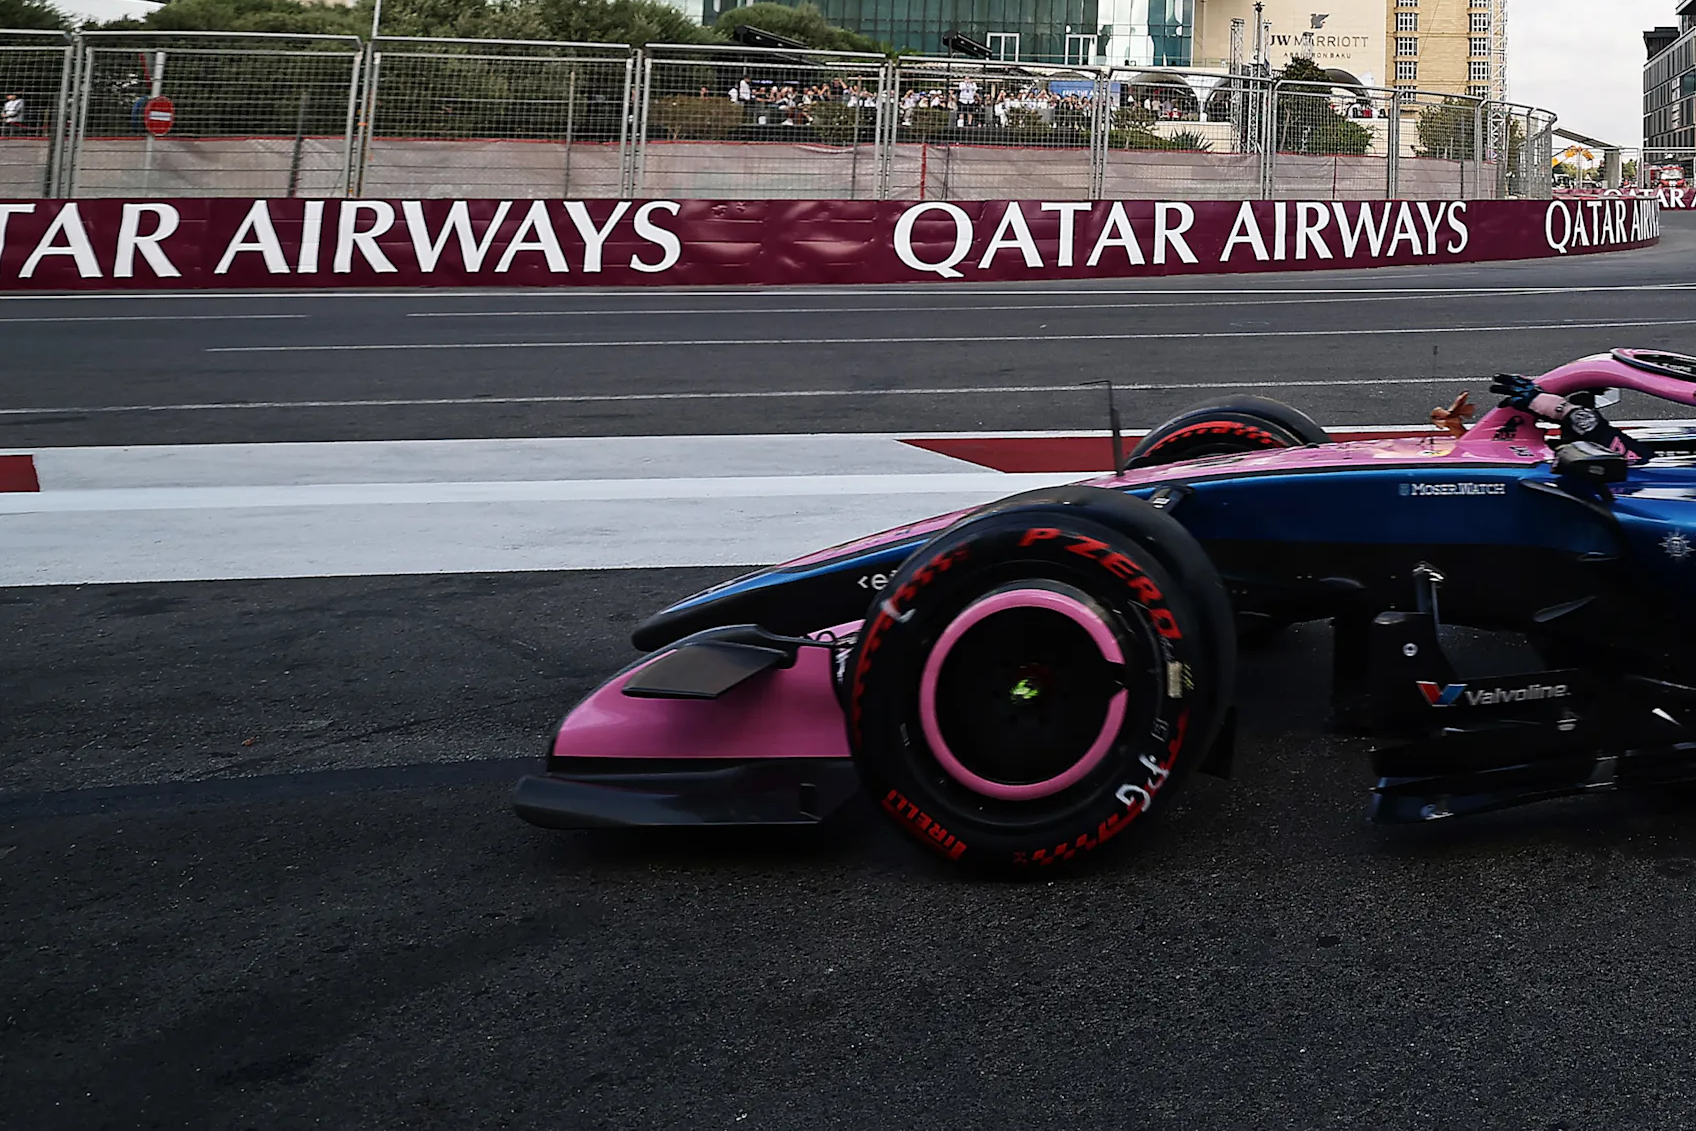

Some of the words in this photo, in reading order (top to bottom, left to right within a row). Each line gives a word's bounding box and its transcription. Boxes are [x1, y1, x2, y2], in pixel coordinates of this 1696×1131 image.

[1269, 35, 1292, 46] JW
[1294, 35, 1369, 47] MRRIOTT
[214, 200, 681, 274] AIRWAYS
[892, 201, 1199, 278] QATAR
[1220, 200, 1469, 262] AIRWAYS
[1545, 200, 1628, 254] QATAR
[1017, 527, 1062, 547] P
[1064, 534, 1183, 639] ZERO
